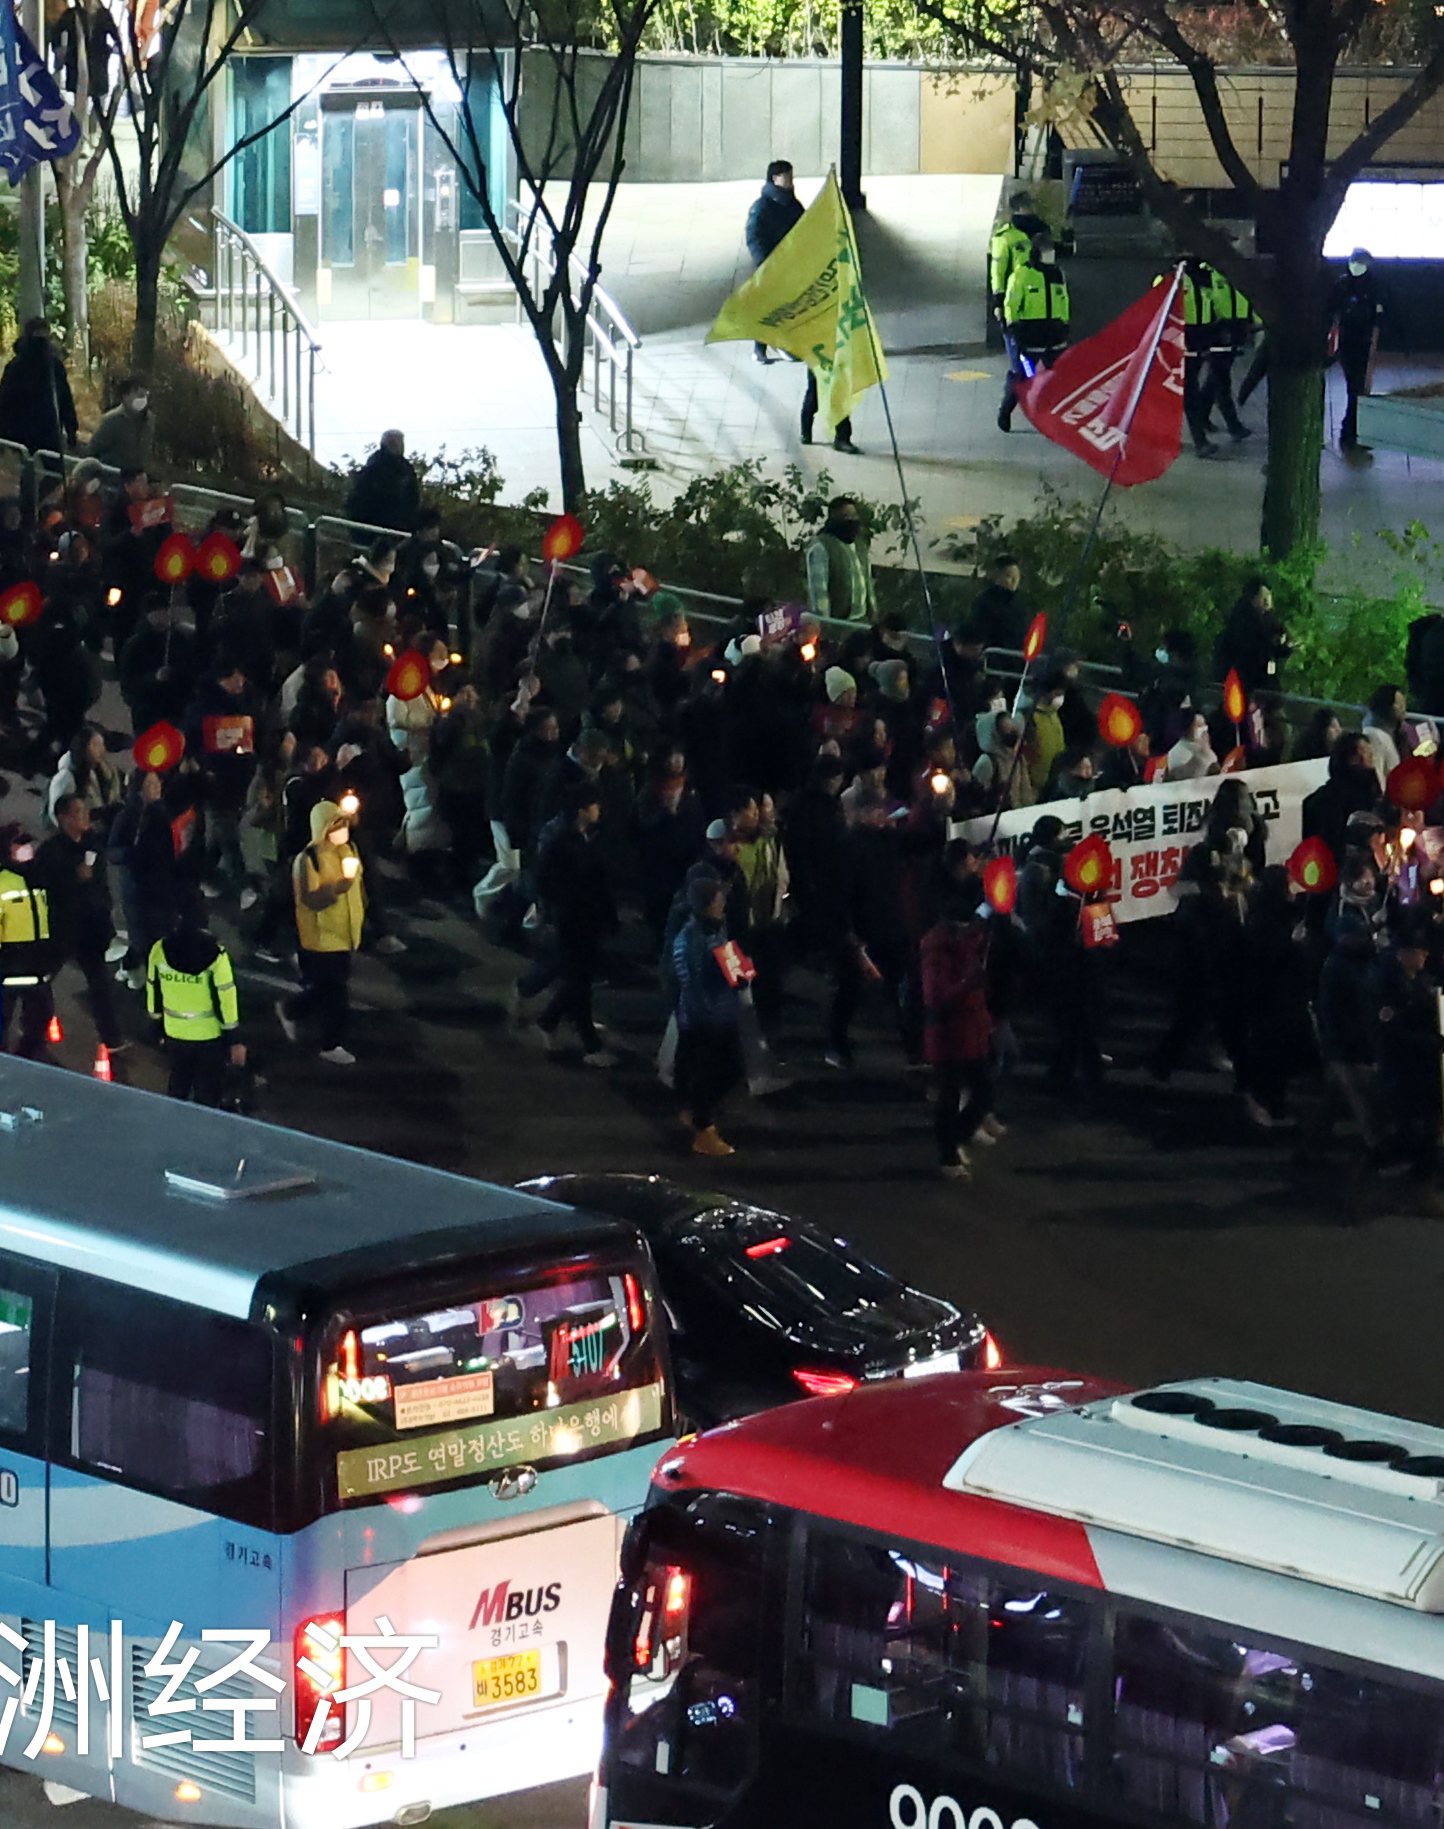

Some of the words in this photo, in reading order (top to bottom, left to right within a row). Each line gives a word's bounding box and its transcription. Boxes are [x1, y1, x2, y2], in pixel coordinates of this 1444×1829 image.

[366, 1452, 423, 1483] IRP도
[427, 1422, 525, 1464] 연말정산도
[224, 1541, 275, 1571] 경기고속
[490, 1619, 545, 1647] 경기고속
[890, 1783, 1040, 1829] 900
